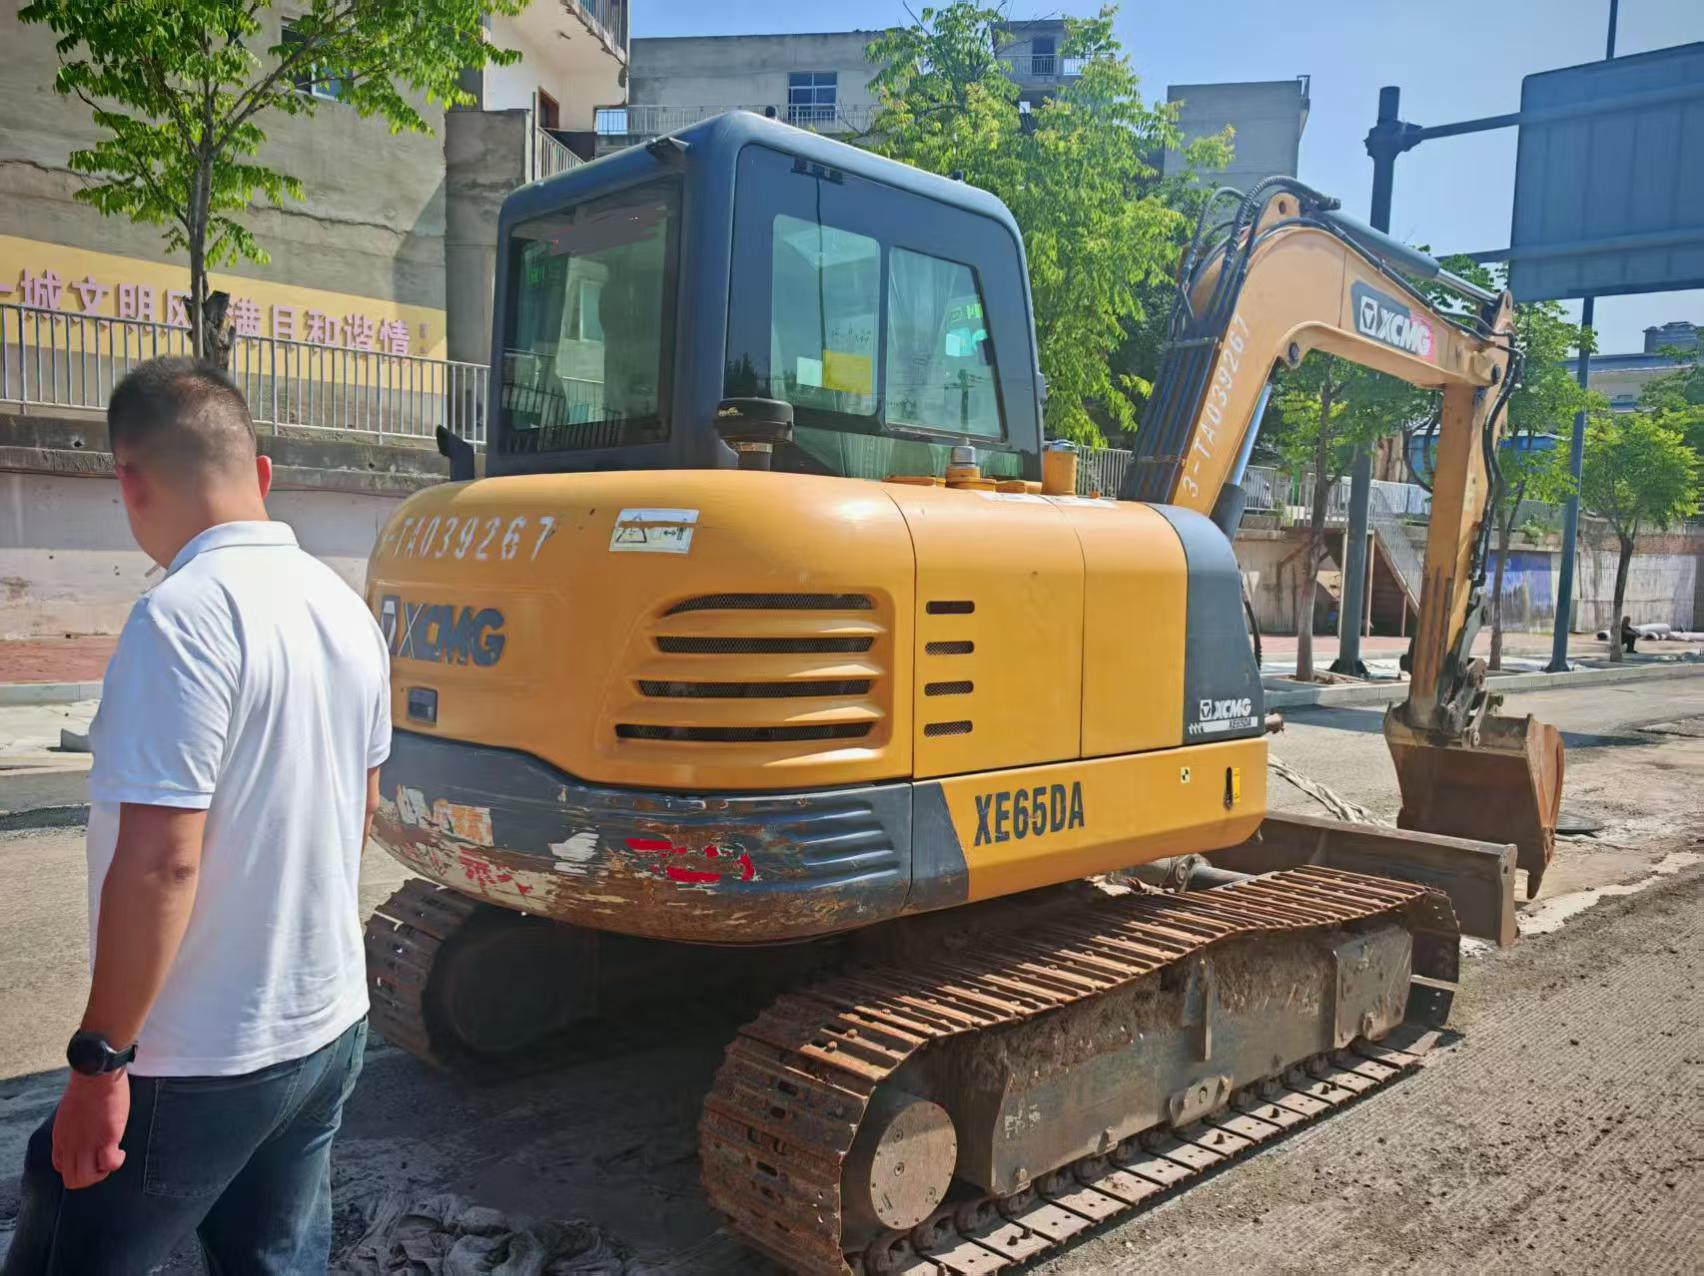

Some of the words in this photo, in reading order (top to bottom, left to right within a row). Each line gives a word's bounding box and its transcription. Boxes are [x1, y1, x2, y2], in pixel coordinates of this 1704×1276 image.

[1376, 305, 1432, 356] XCMG
[398, 602, 506, 668] XCMG
[1212, 697, 1252, 720] XCMG
[973, 780, 1086, 847] XE65DA
